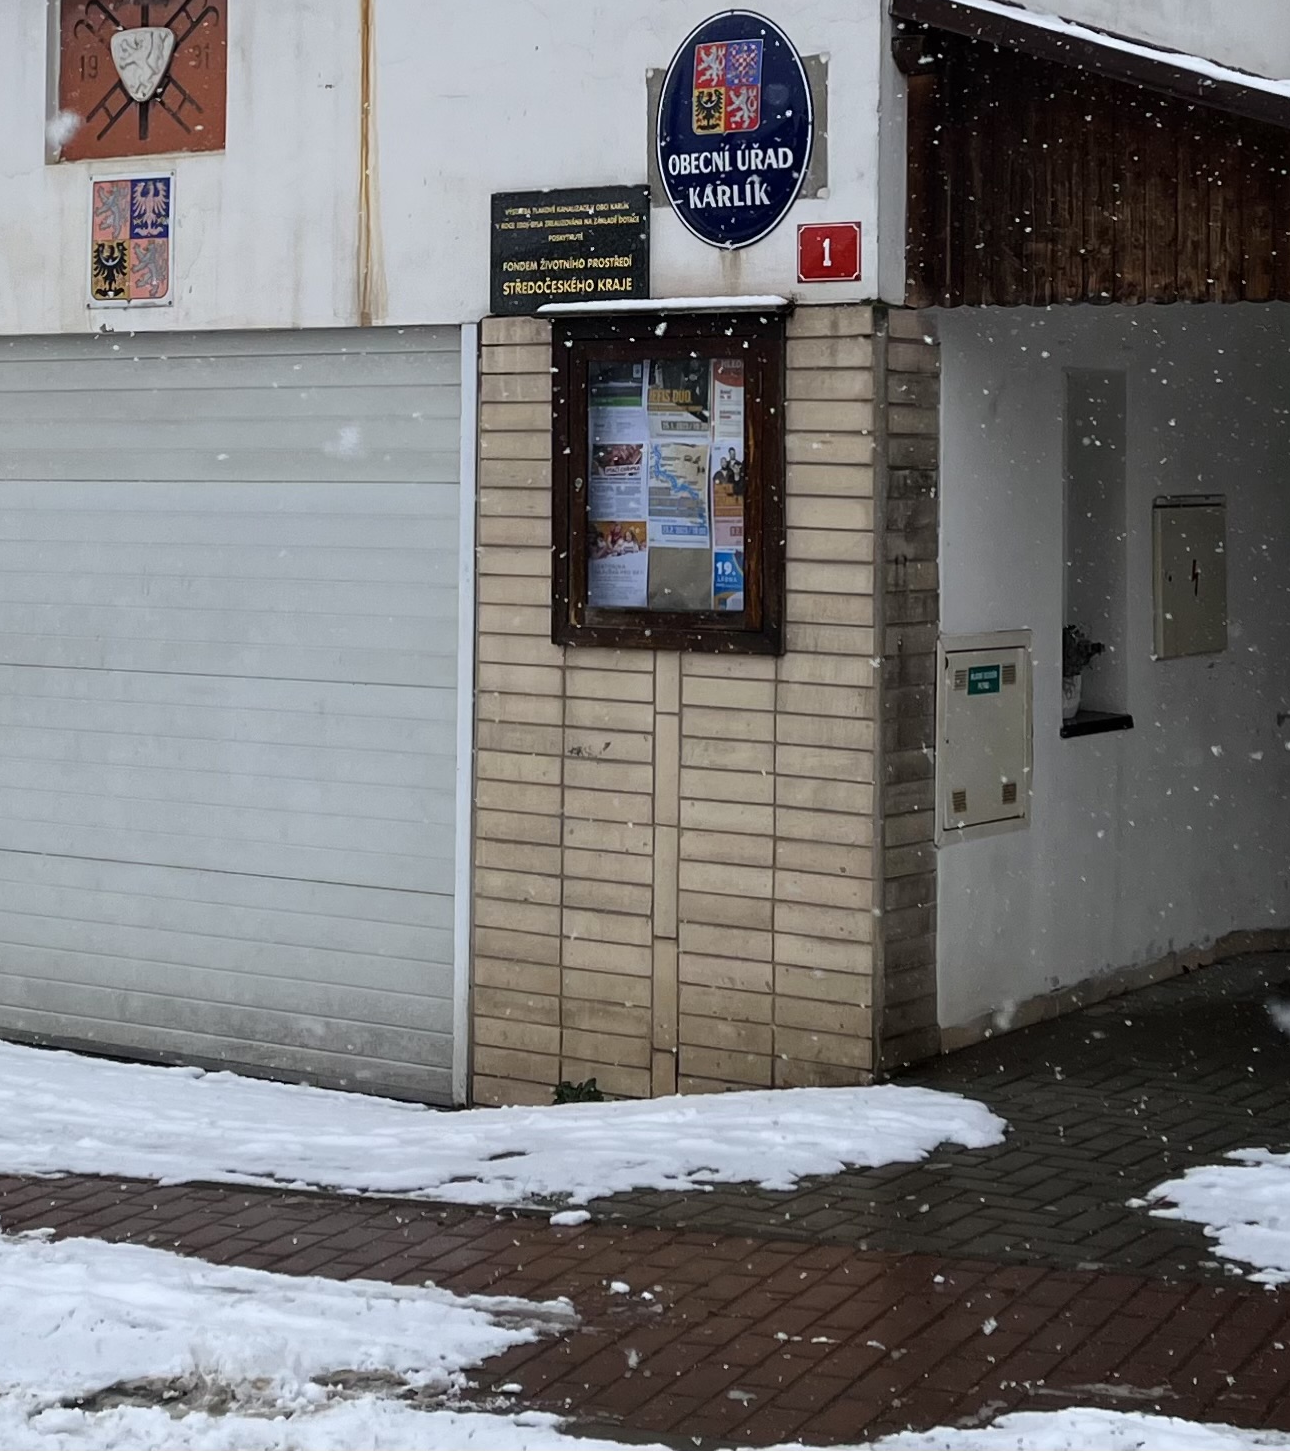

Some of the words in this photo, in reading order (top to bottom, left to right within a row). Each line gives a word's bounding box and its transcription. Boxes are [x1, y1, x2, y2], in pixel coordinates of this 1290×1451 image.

[668, 144, 731, 176] OBECNÍ
[737, 142, 794, 170] ÚŘAD
[822, 238, 832, 267] 1
[503, 260, 538, 272] FONDEM
[540, 256, 586, 271] ŽIVOTNÍHO
[587, 254, 633, 268] PROSTŘEDÍ
[503, 277, 594, 295] STŘEDOČESKÉHO
[597, 277, 633, 292] KRAJE
[716, 561, 737, 576] 19.
